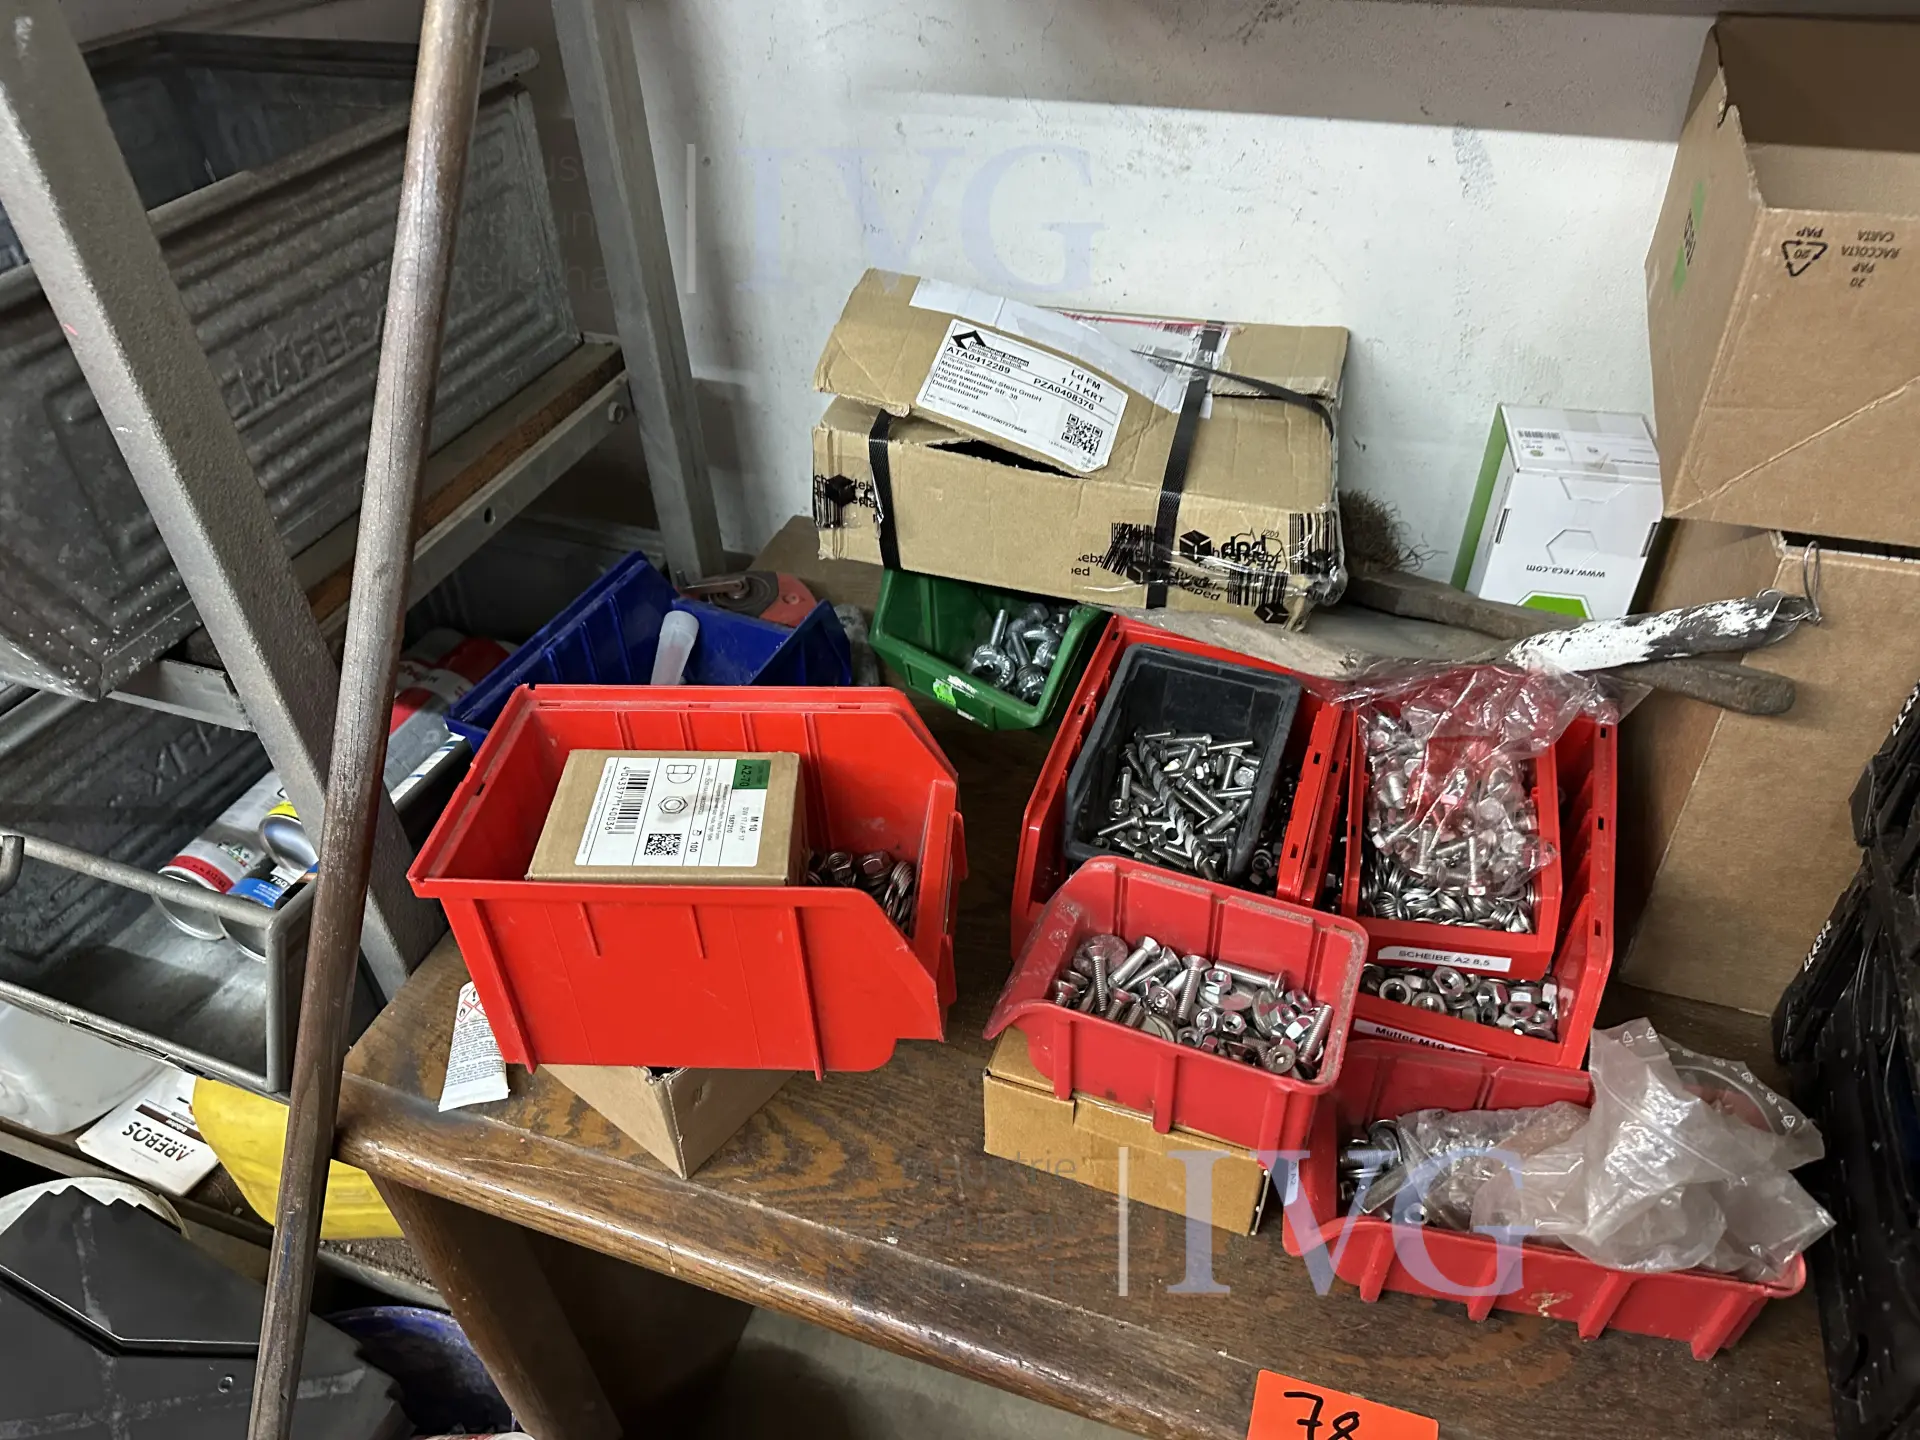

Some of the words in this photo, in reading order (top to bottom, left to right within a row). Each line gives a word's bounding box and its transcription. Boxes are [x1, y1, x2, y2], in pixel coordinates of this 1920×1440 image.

[1796, 227, 1824, 238] PAP
[1858, 230, 1895, 242] CARTA
[1793, 249, 1812, 260] 20
[1841, 246, 1901, 259] RACCOLTA
[1852, 262, 1875, 273] PAP
[1849, 278, 1866, 288] 20
[946, 345, 1011, 375] ATA0412289
[932, 379, 980, 401] Deutschland
[958, 380, 988, 397] Bautzen
[1086, 377, 1102, 391] FM
[1019, 387, 1043, 403] GmbH
[1033, 377, 1095, 412] PZA0408376
[1082, 385, 1105, 404] KRT
[1220, 535, 1266, 562] dpd
[1526, 564, 1606, 578] www.reca.com
[739, 764, 752, 787] A2-70
[689, 841, 699, 853] 100
[269, 875, 288, 888] 750
[1398, 949, 1452, 963] SCHEIBE
[1454, 957, 1470, 965] A2
[1375, 1026, 1416, 1045] Mutter
[122, 1120, 196, 1162] AREBOS
